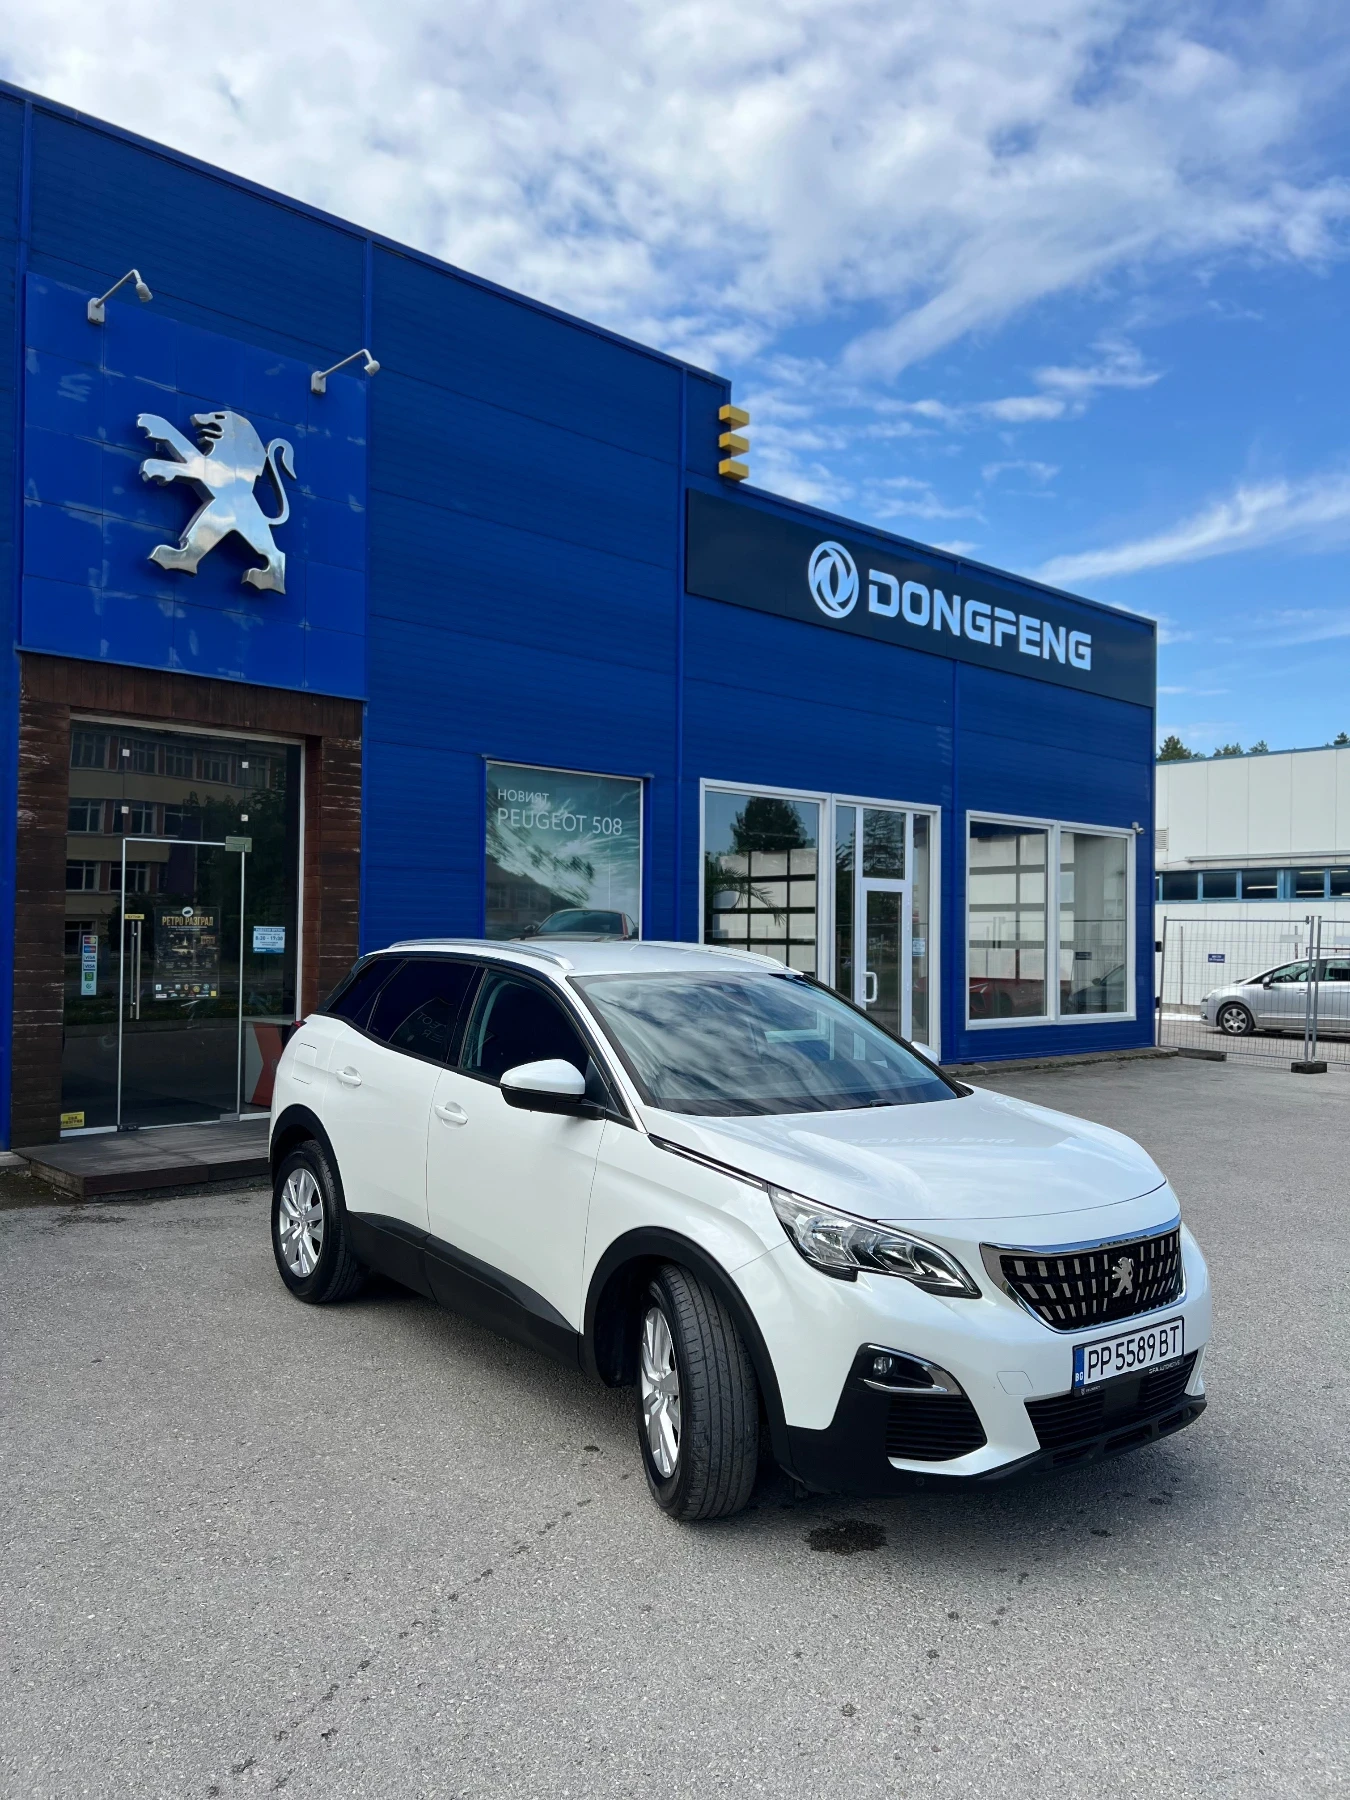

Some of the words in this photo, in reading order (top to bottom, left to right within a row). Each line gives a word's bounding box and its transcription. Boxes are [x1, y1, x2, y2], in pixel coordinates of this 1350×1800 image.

[868, 568, 1092, 671] DONGFENG
[498, 789, 549, 803] НОВИЯТ
[497, 808, 587, 832] PEUGEOT
[592, 816, 622, 835] 508
[162, 916, 184, 926] РЕТРО
[185, 916, 214, 927] РАЗГРАД
[1075, 1372, 1084, 1381] BG
